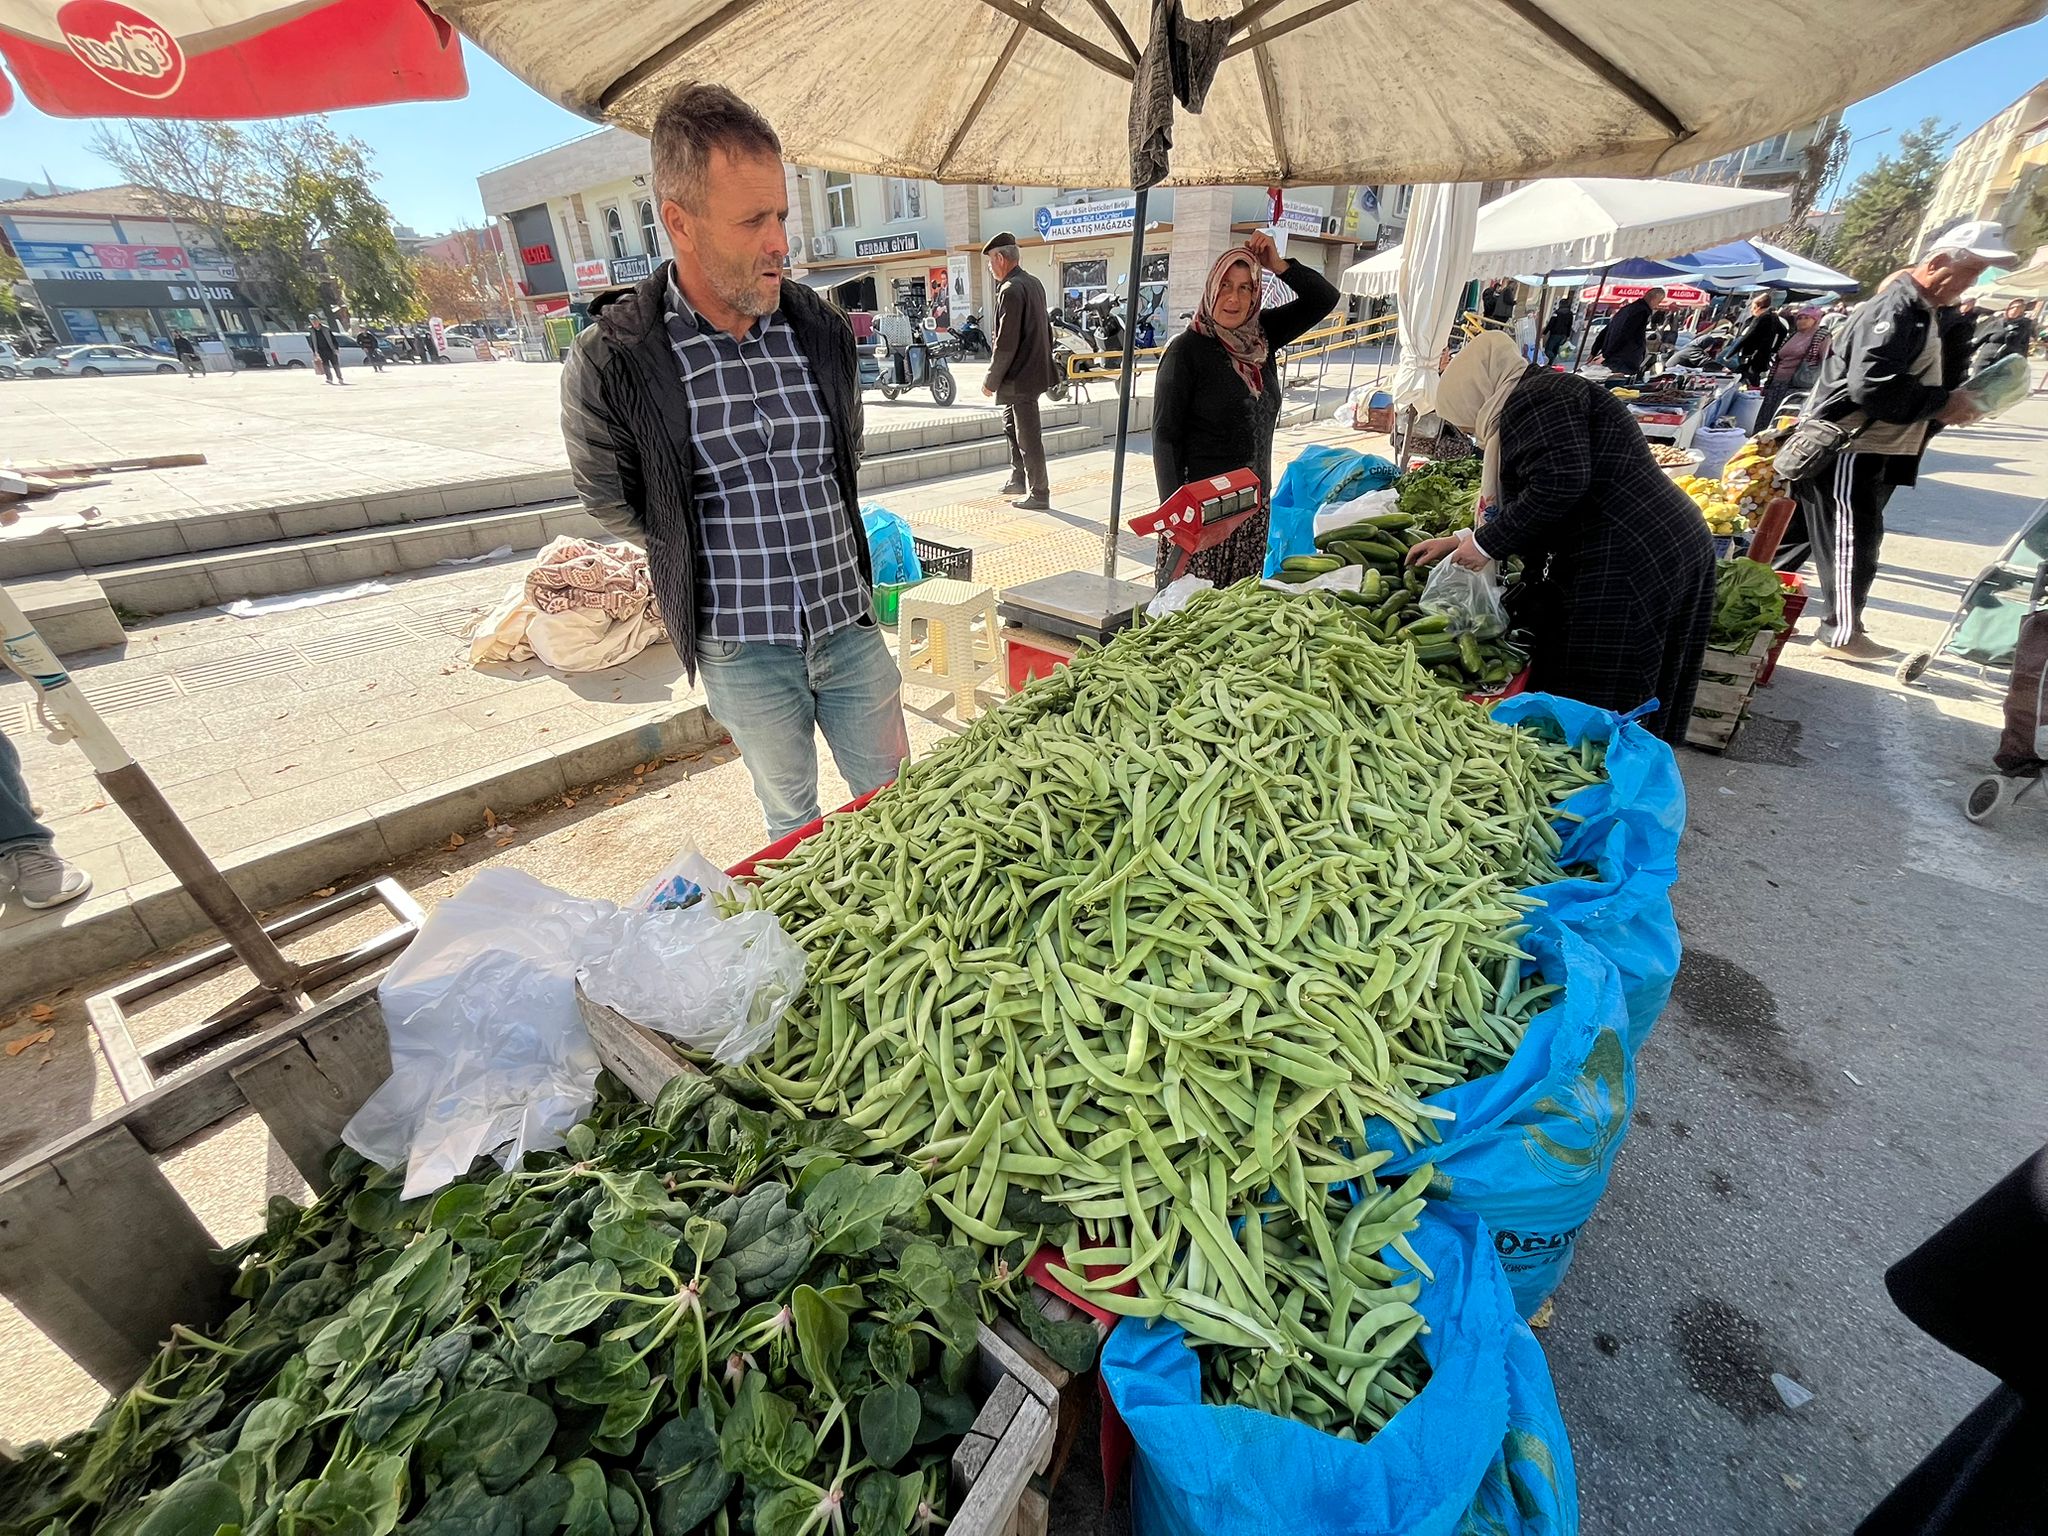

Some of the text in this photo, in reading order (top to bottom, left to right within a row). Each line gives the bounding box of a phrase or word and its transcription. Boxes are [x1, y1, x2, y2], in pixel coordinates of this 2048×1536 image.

[1061, 216, 1073, 225] Süt
[1083, 213, 1095, 222] Süt
[1051, 226, 1072, 237] HALK
[1072, 222, 1093, 235] SATIŞ
[858, 236, 915, 256] SERDAR GİYİM
